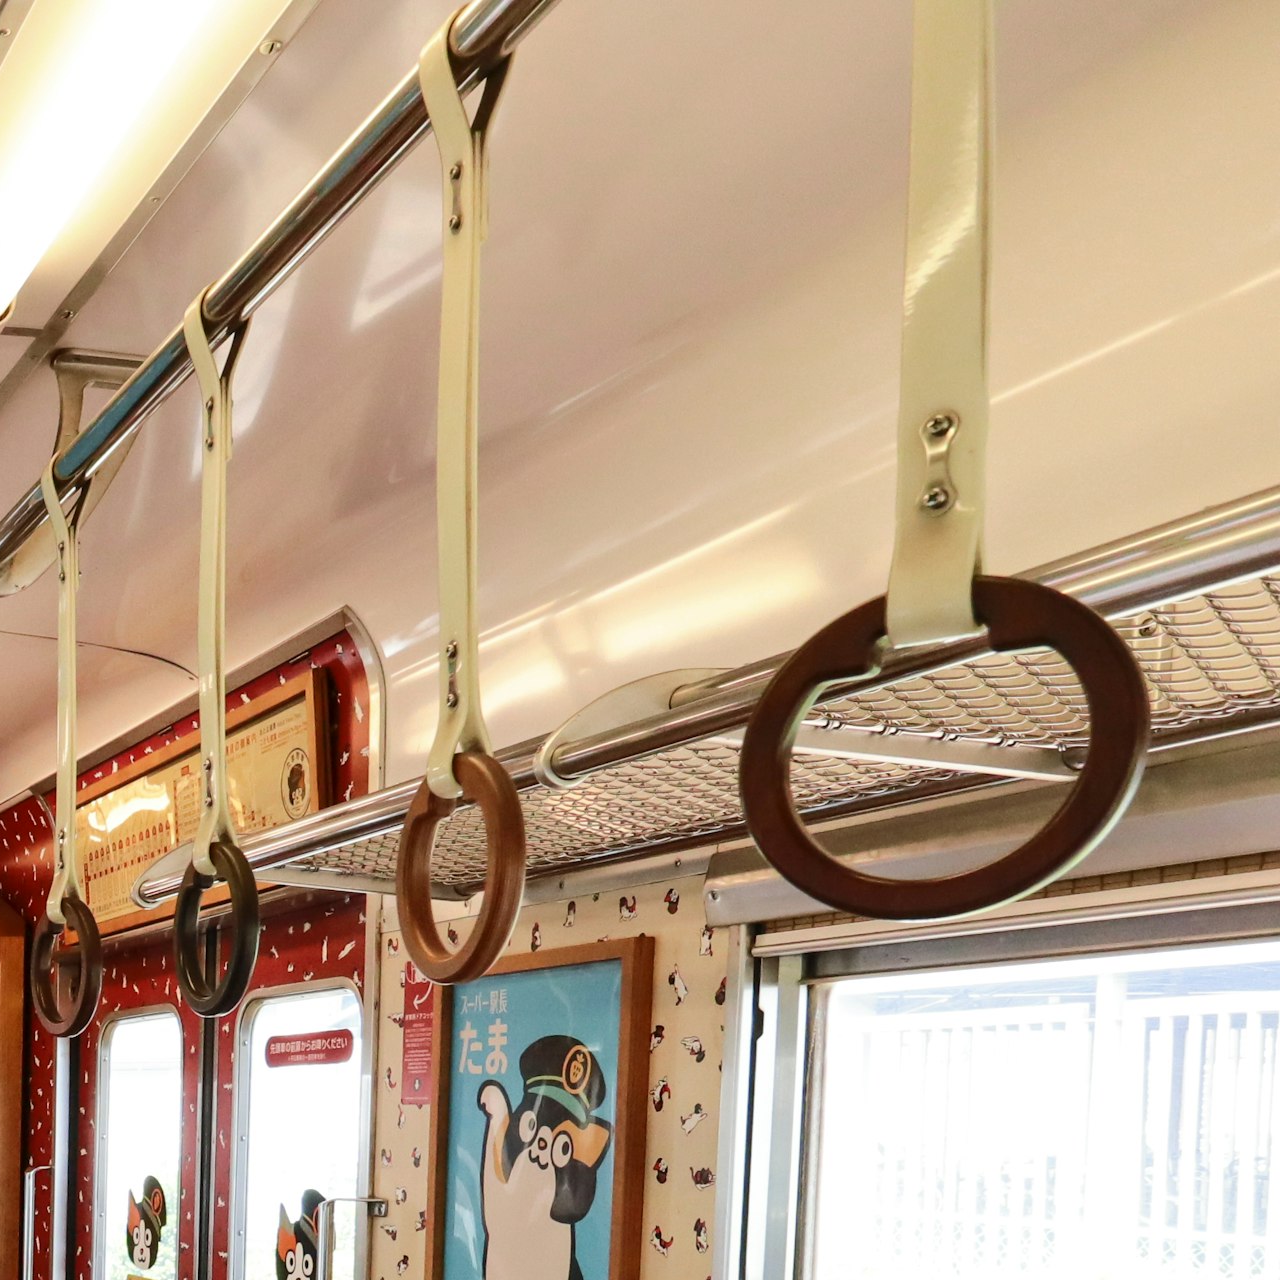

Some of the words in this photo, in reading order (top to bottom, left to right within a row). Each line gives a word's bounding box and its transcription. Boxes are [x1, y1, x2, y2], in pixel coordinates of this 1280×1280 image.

[461, 988, 508, 1015] スーパー駅長
[458, 1018, 508, 1075] たま
